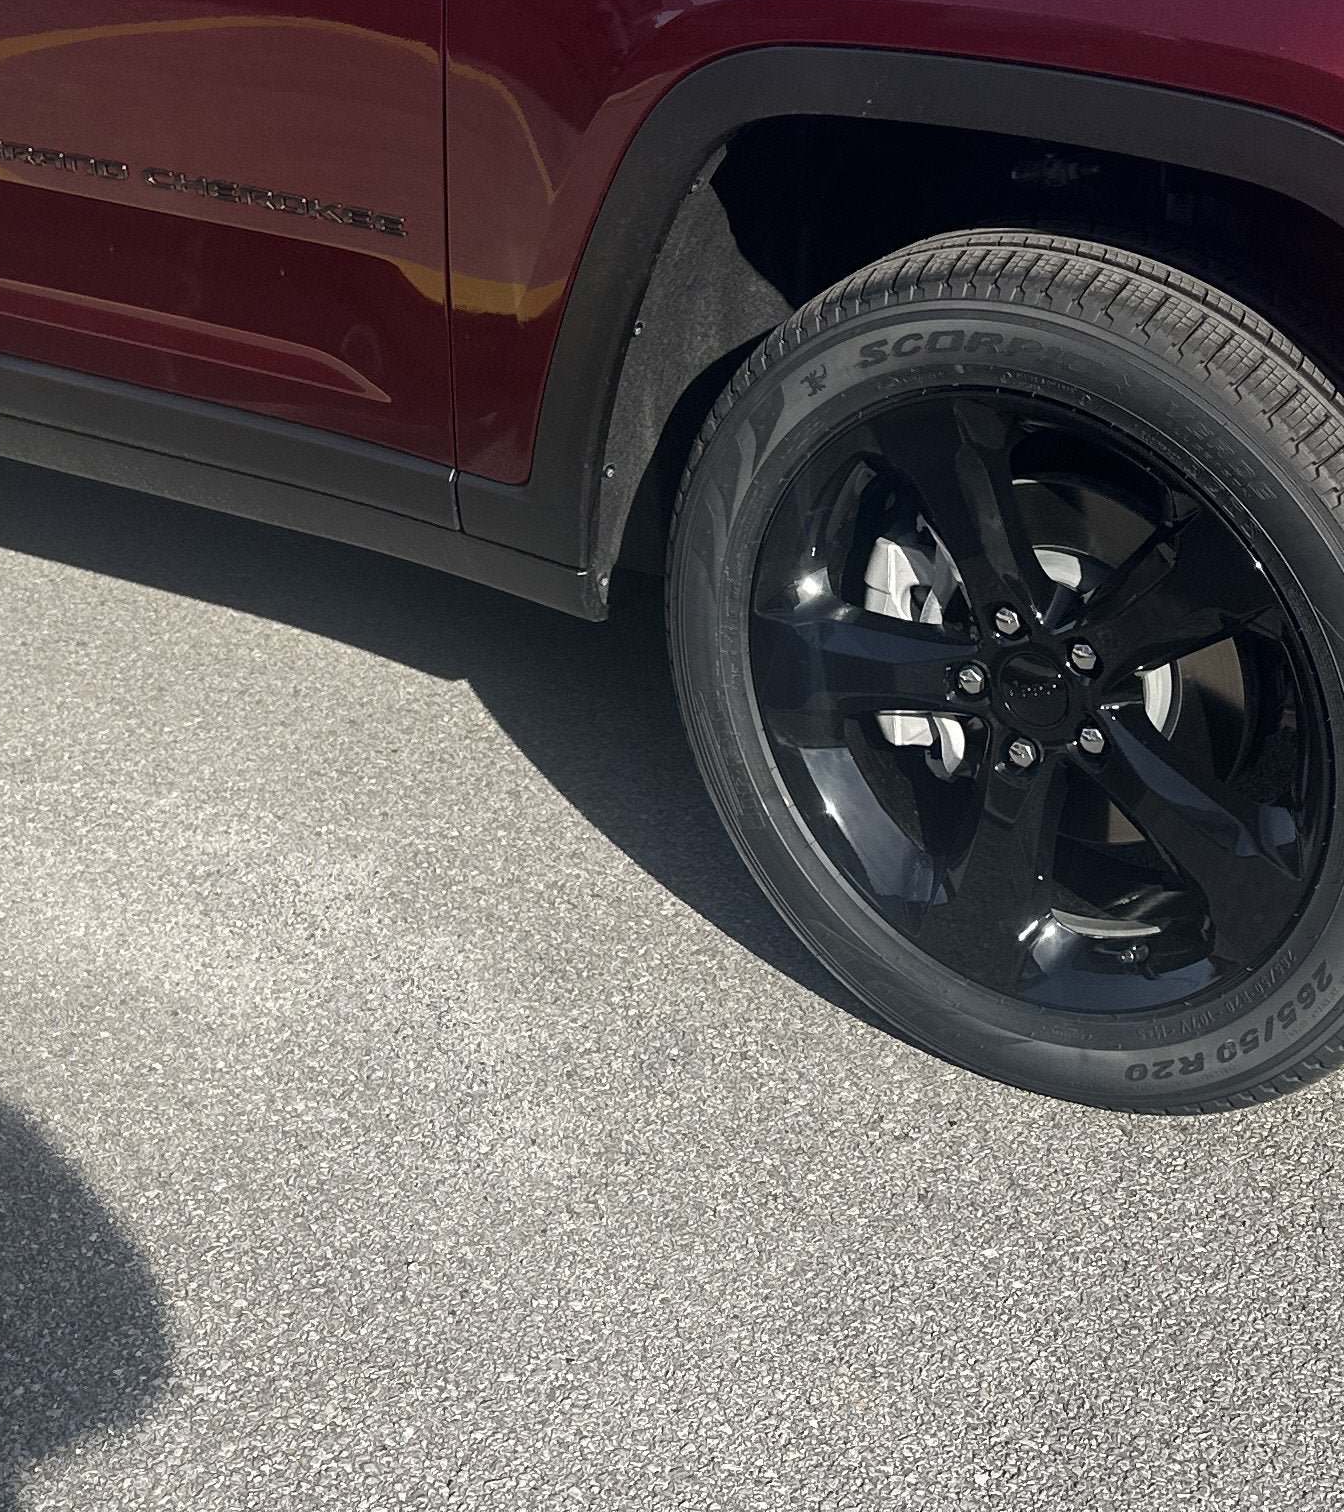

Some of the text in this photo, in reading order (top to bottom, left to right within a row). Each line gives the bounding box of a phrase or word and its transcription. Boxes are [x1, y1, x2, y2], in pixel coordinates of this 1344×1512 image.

[141, 167, 407, 236] CHEROKEE
[1216, 958, 1334, 1065] 265/50
[1124, 1051, 1205, 1082] R20
